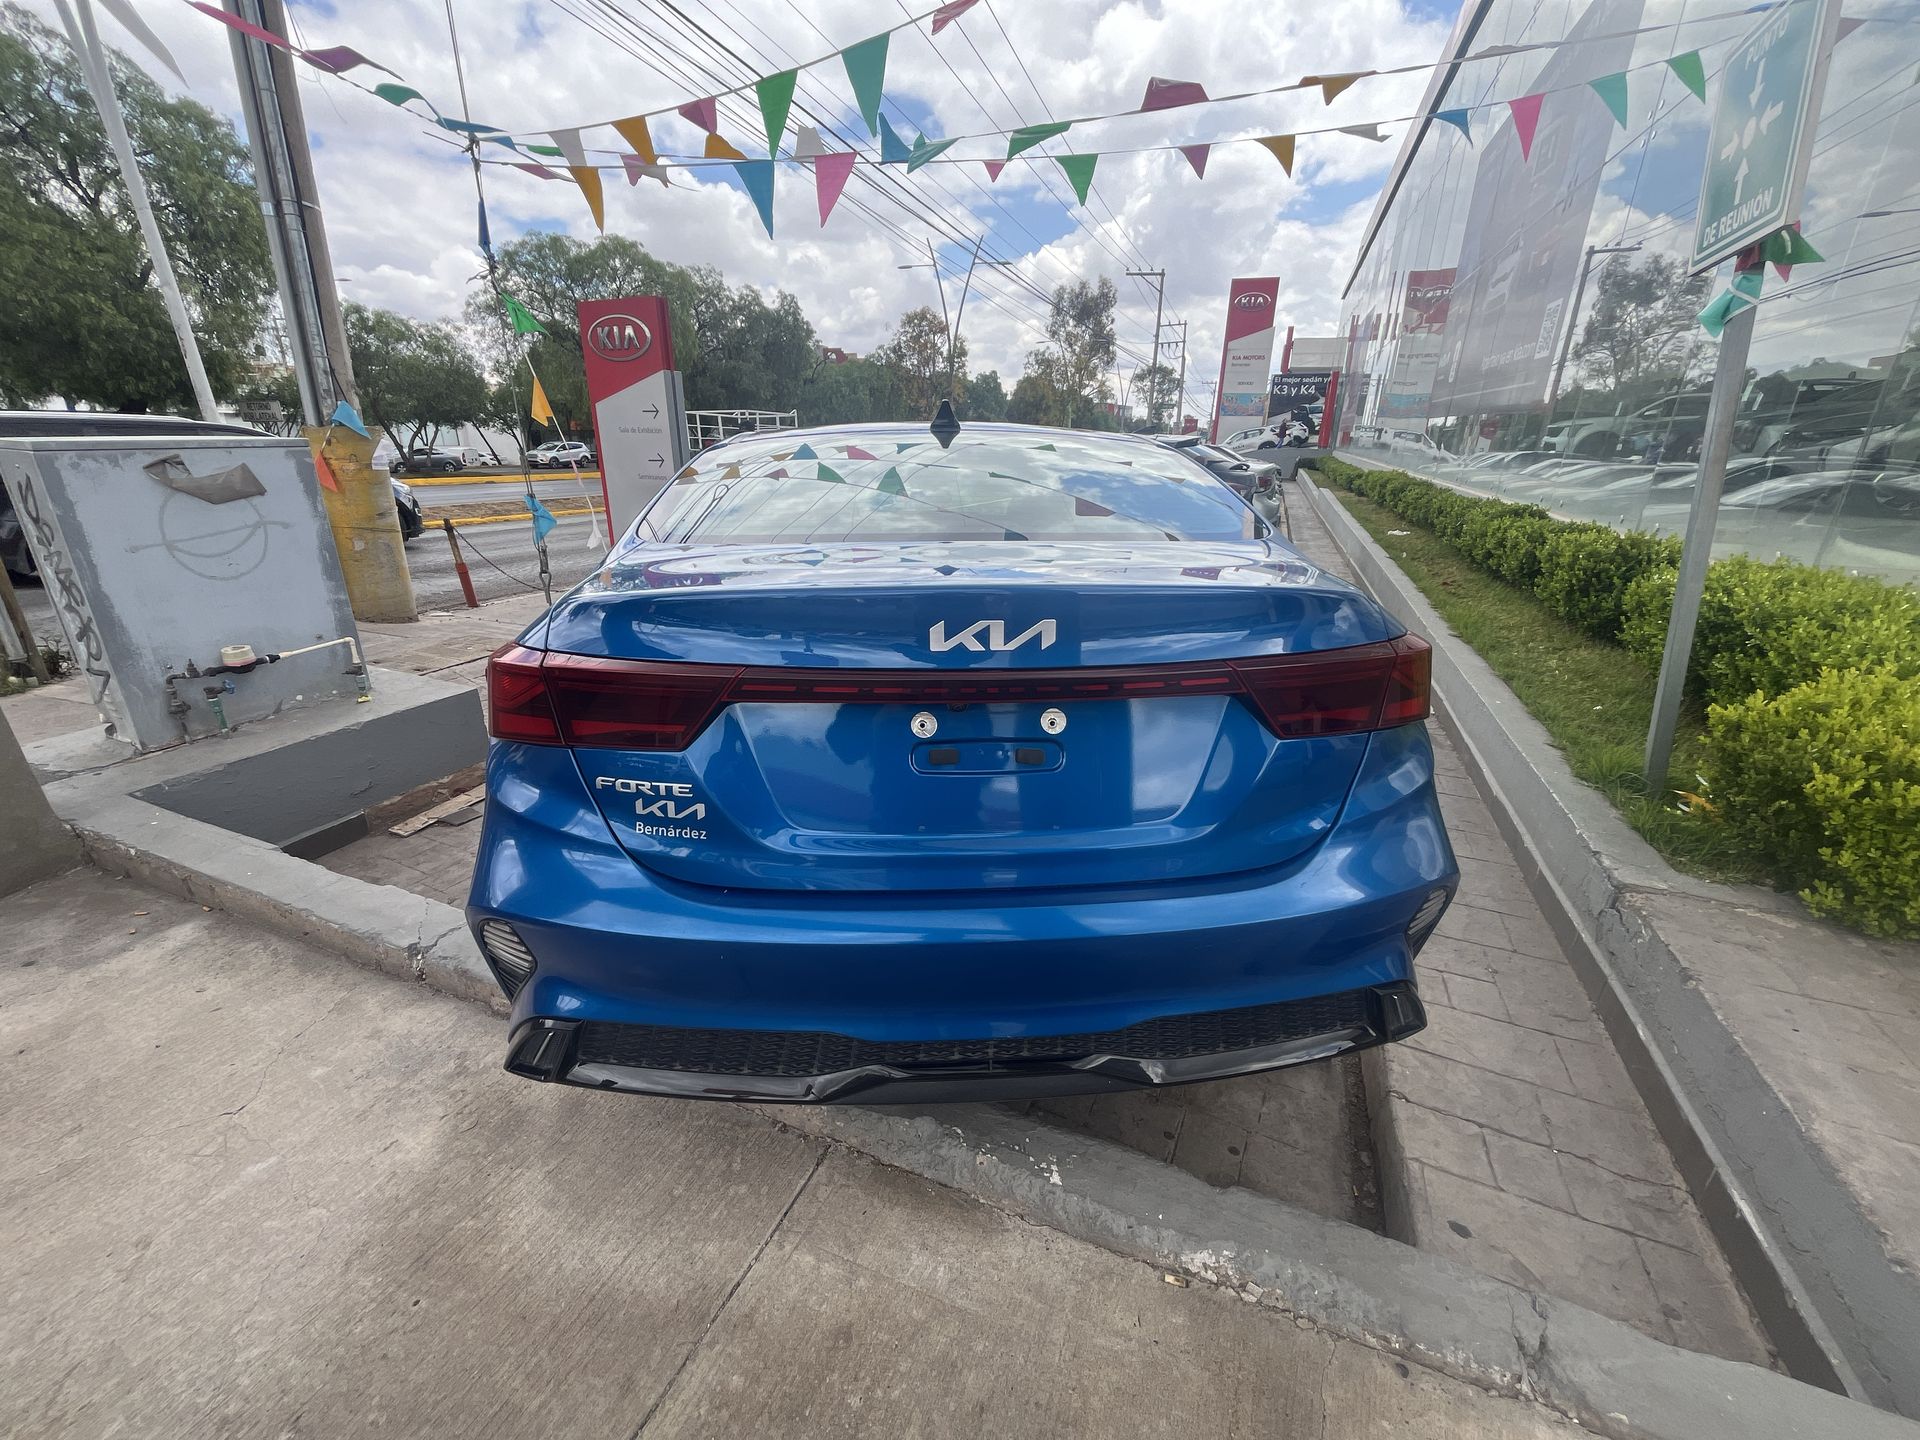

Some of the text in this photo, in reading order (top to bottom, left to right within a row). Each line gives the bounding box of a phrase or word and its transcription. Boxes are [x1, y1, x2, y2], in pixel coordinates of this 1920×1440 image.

[1745, 13, 1789, 70] PUNTO
[1703, 187, 1773, 247] DE REUNIÓN
[1241, 296, 1265, 307] KIA
[596, 324, 641, 351] KIA
[1273, 384, 1316, 396] K3 y K4
[1282, 376, 1301, 384] mejor
[929, 619, 1057, 651] KIA
[595, 776, 693, 797] FORTE
[635, 798, 706, 820] KIA
[635, 821, 707, 840] Bernárdez
